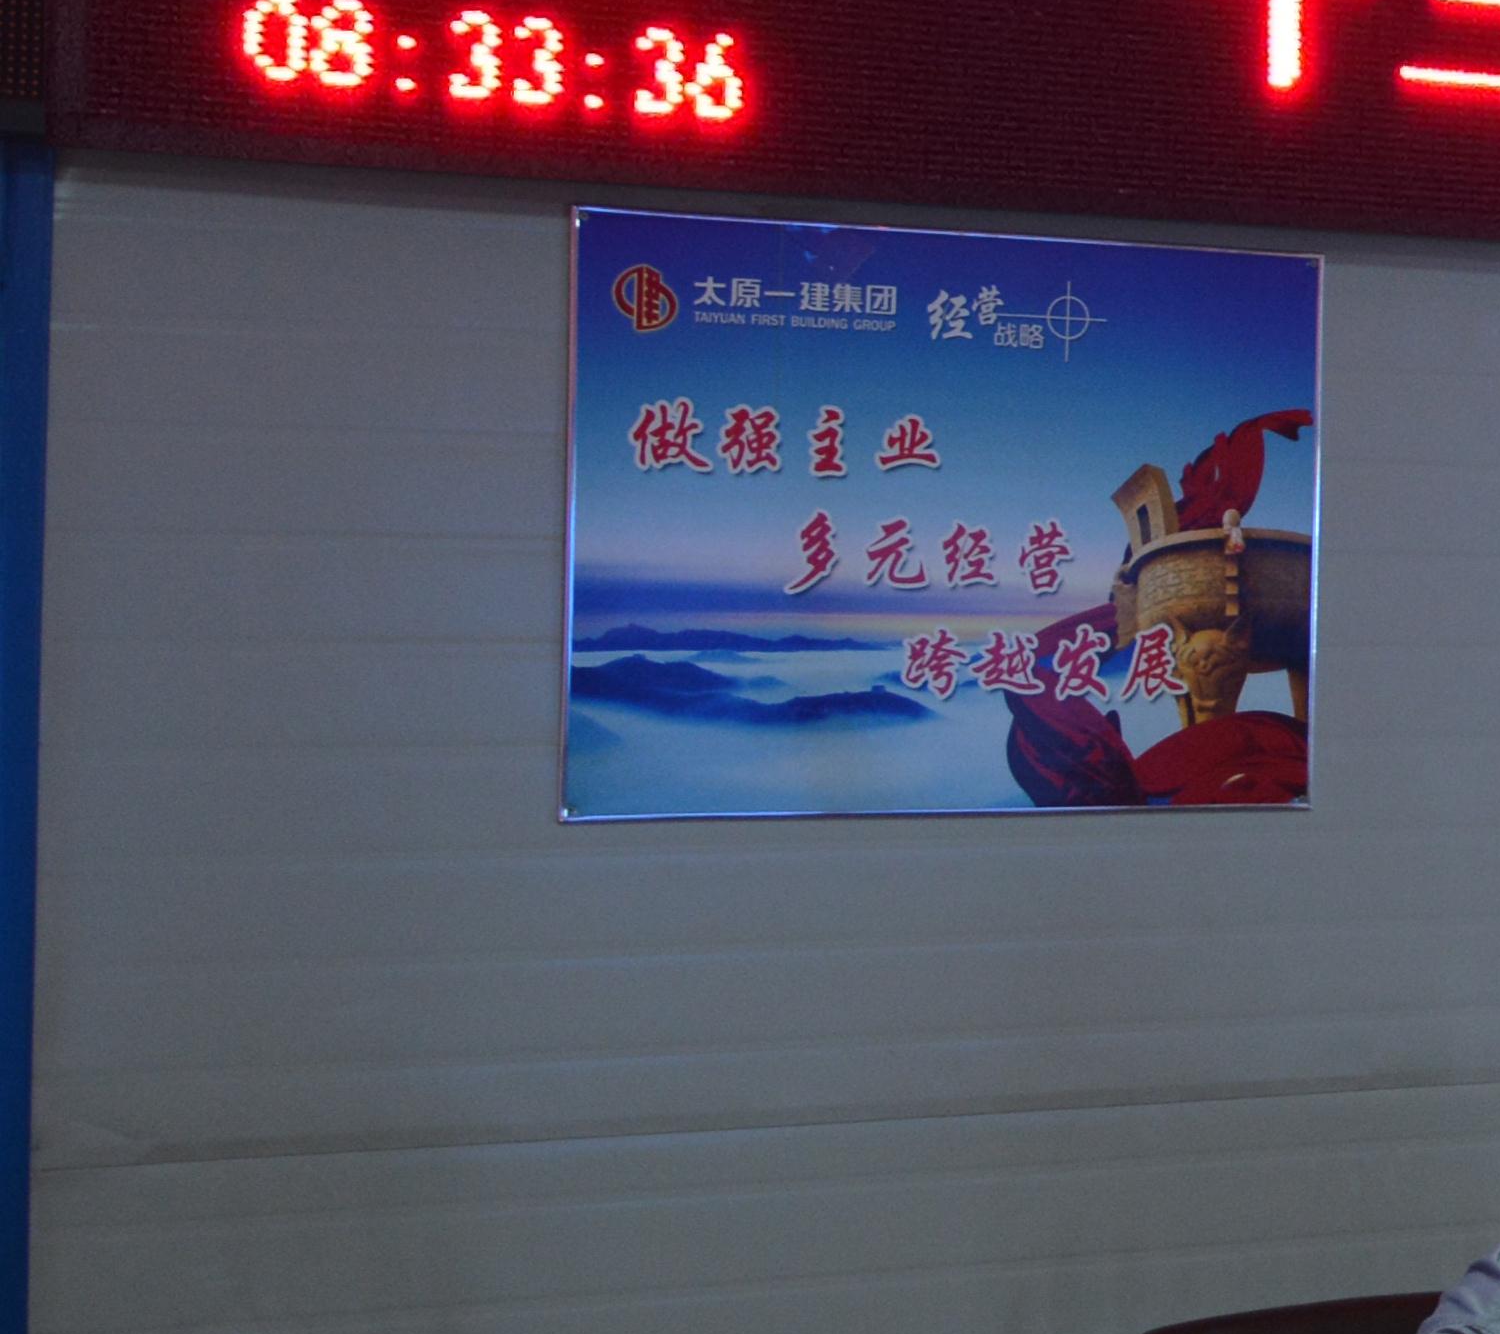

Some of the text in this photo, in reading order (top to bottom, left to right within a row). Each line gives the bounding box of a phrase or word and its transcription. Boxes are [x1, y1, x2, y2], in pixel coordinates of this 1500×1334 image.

[692, 275, 898, 316] 太原一建集团
[694, 310, 897, 333] TAIYUAN FIRST BUILDING GROUP
[928, 284, 1004, 341] 经营
[994, 322, 1045, 350] 战略
[630, 397, 941, 477] 做强主业
[784, 510, 1073, 595] 多元经营
[901, 624, 1187, 702] 跨越发展
